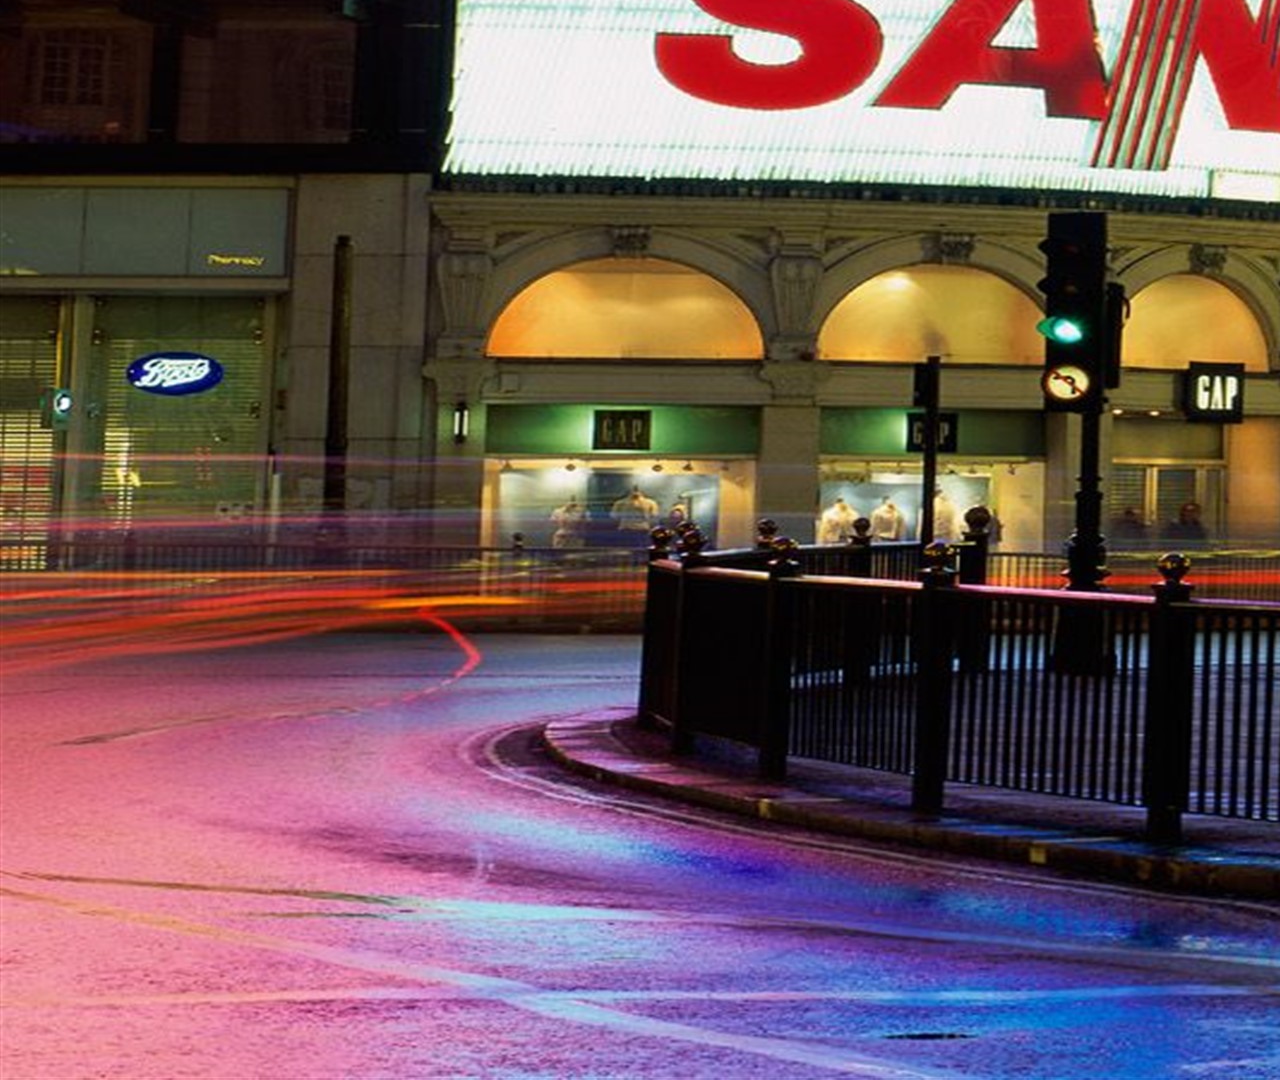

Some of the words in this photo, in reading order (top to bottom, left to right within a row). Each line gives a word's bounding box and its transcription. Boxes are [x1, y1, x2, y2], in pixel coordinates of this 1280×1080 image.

[133, 358, 211, 387] Boots
[1196, 375, 1238, 410] GAP
[912, 421, 950, 446] GP
